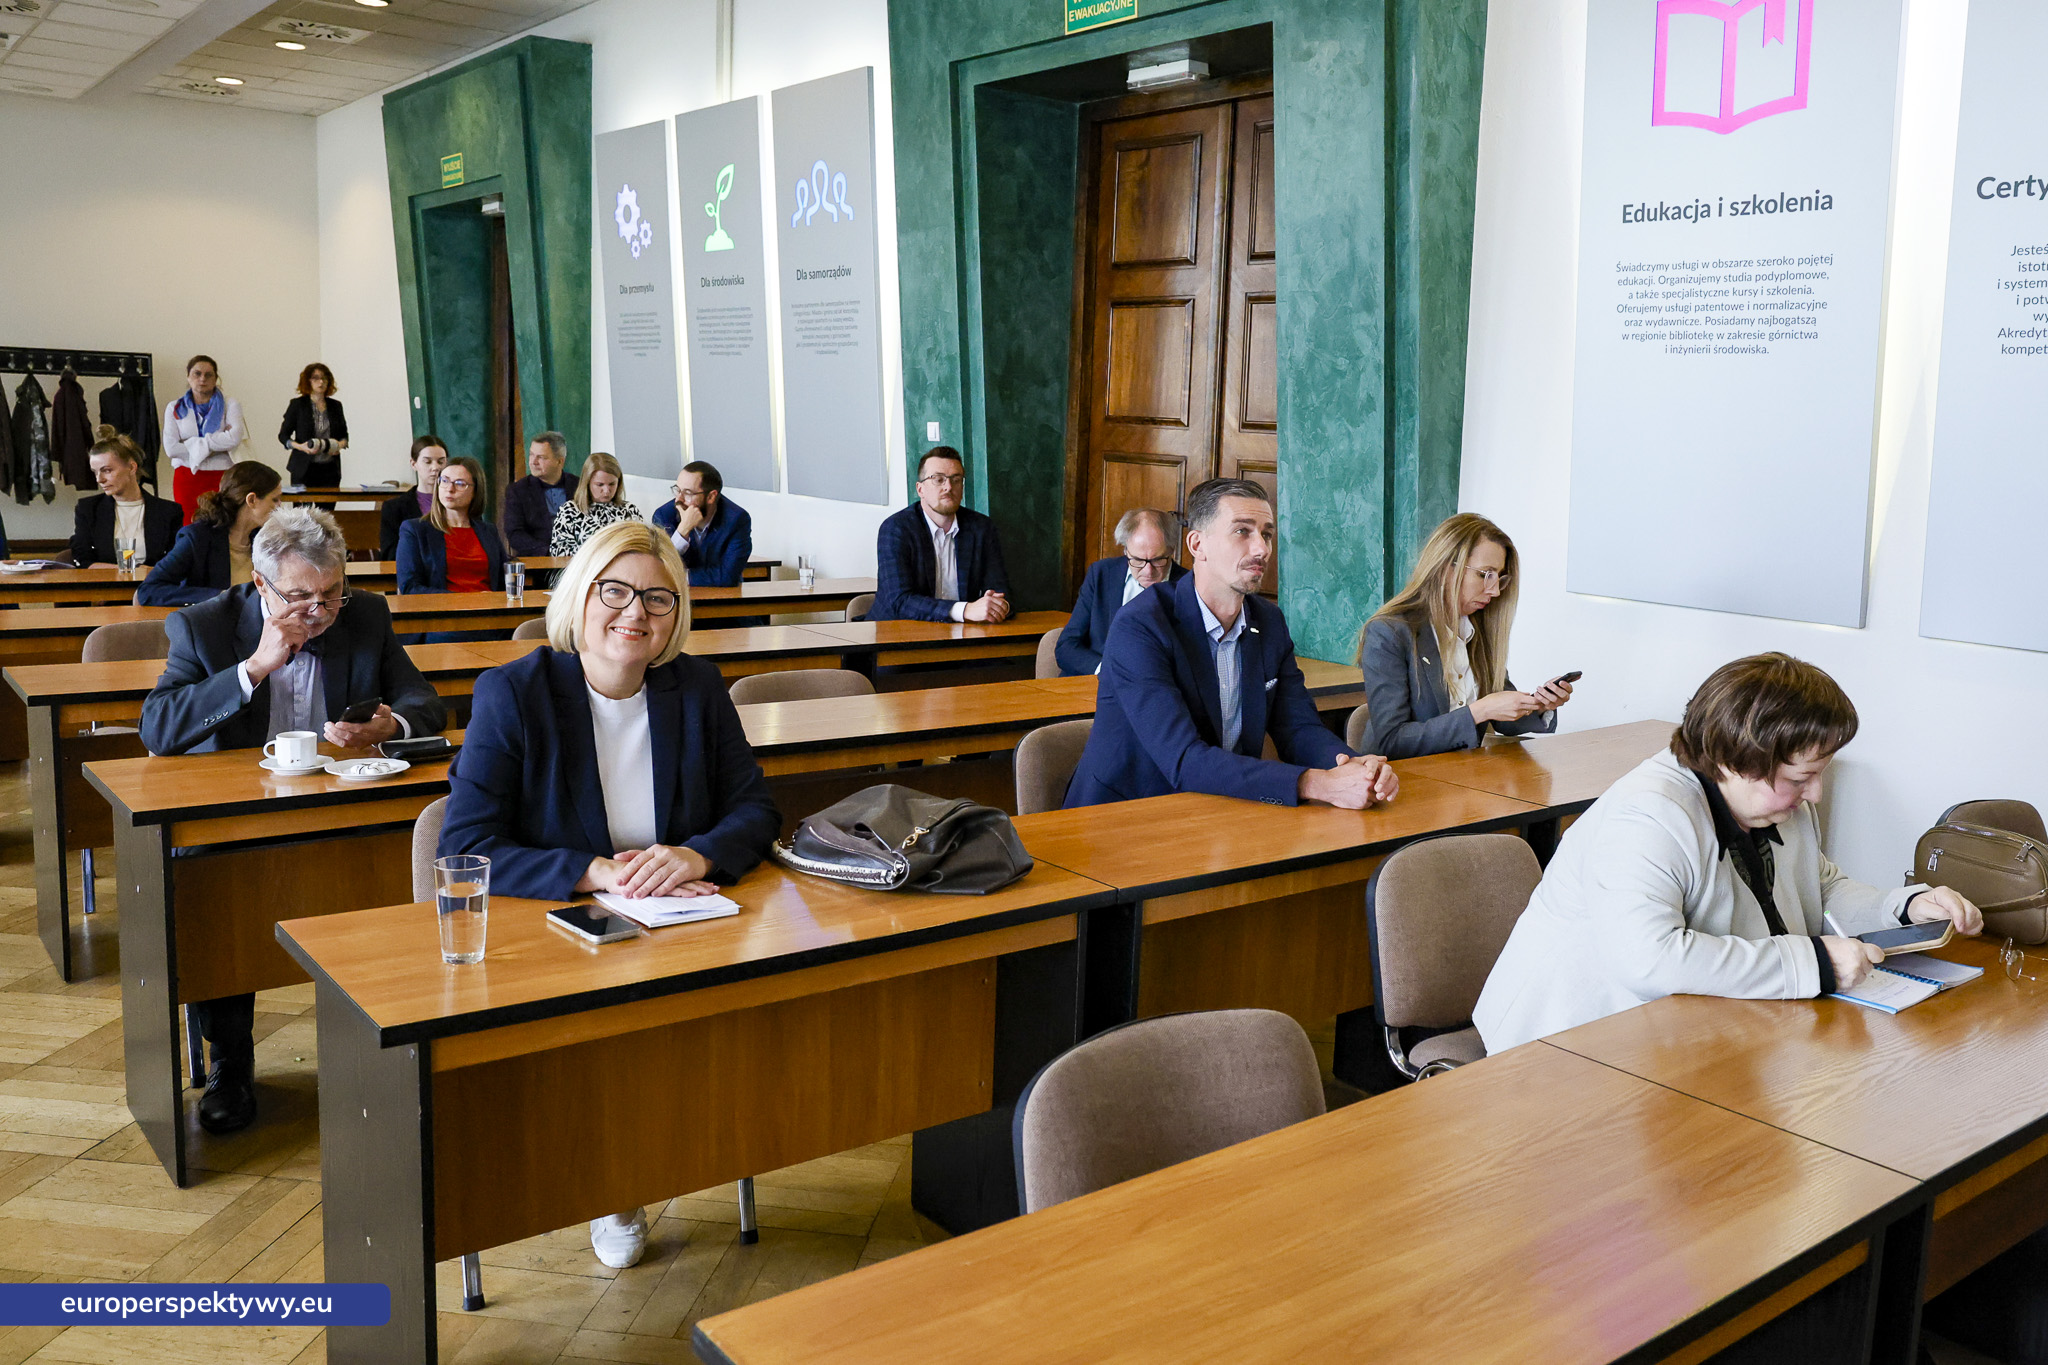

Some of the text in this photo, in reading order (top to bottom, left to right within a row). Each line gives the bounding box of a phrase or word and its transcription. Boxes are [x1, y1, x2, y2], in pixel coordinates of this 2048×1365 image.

[1068, 0, 1133, 22] EWAKUACYJNE
[1977, 175, 2048, 200] Certy
[1622, 199, 1711, 224] Edukacja
[1729, 189, 1833, 217] szkolenia
[1616, 261, 1669, 272] Świadczymy
[1672, 260, 1699, 271] usługi
[1712, 259, 1753, 268] obszarze
[1757, 256, 1794, 266] szeroko
[1798, 254, 1833, 266] pojętej
[796, 265, 852, 281] Dla samorządów
[1618, 270, 1829, 287] edukacji. Organizujemy studia podyplomowe,
[701, 274, 744, 288] Dla środowiska
[620, 285, 628, 294] Dla
[1636, 290, 1659, 299] także
[1662, 288, 1729, 300] specjalistyczne
[1733, 287, 1758, 297] kursy
[1767, 285, 1814, 295] szkolenia.
[1617, 304, 1662, 314] Oferujemy
[1665, 303, 1691, 314] usługi
[1695, 303, 1744, 313] patentowe
[1753, 300, 1827, 311] normalizacyjne
[1645, 317, 1701, 328] wydawnicze.
[1705, 316, 1755, 327] Posiadamy
[1758, 315, 1816, 327] najbogatszą
[1632, 331, 1666, 342] regionie
[1670, 331, 1713, 341] bibliotekę
[1727, 330, 1765, 339] zakresie
[1769, 330, 1818, 341] górnictwa
[1670, 345, 1710, 355] inżynierii
[1714, 345, 1769, 354] środowiska.
